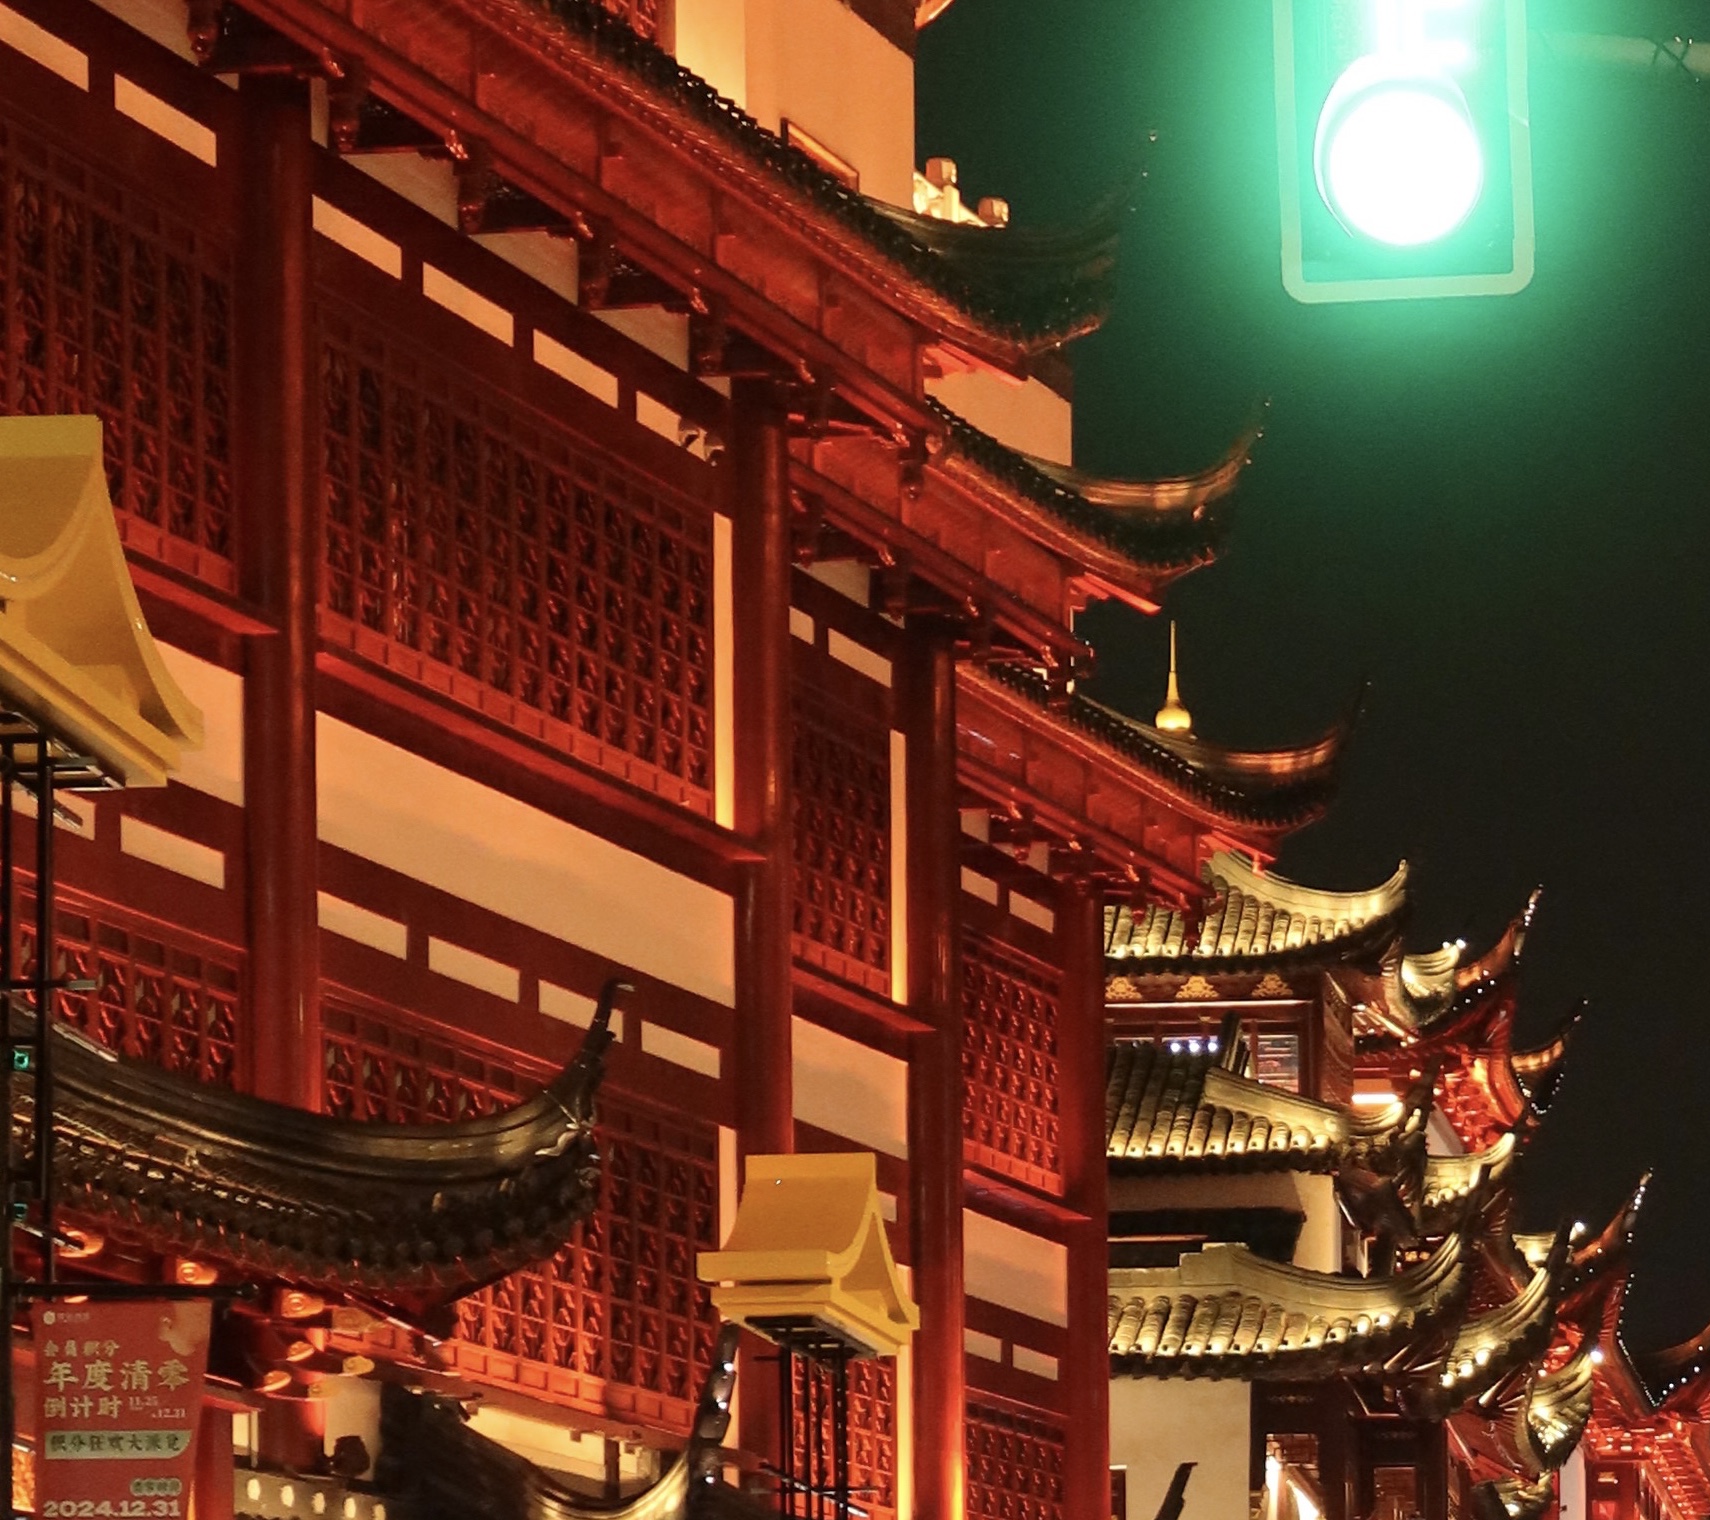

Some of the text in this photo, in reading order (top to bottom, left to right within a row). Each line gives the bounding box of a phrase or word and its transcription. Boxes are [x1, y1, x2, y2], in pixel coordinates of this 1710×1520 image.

[43, 1359, 190, 1392] 年度清零
[43, 1395, 122, 1419] 倒计时
[43, 1499, 181, 1518] 2024.12.31
